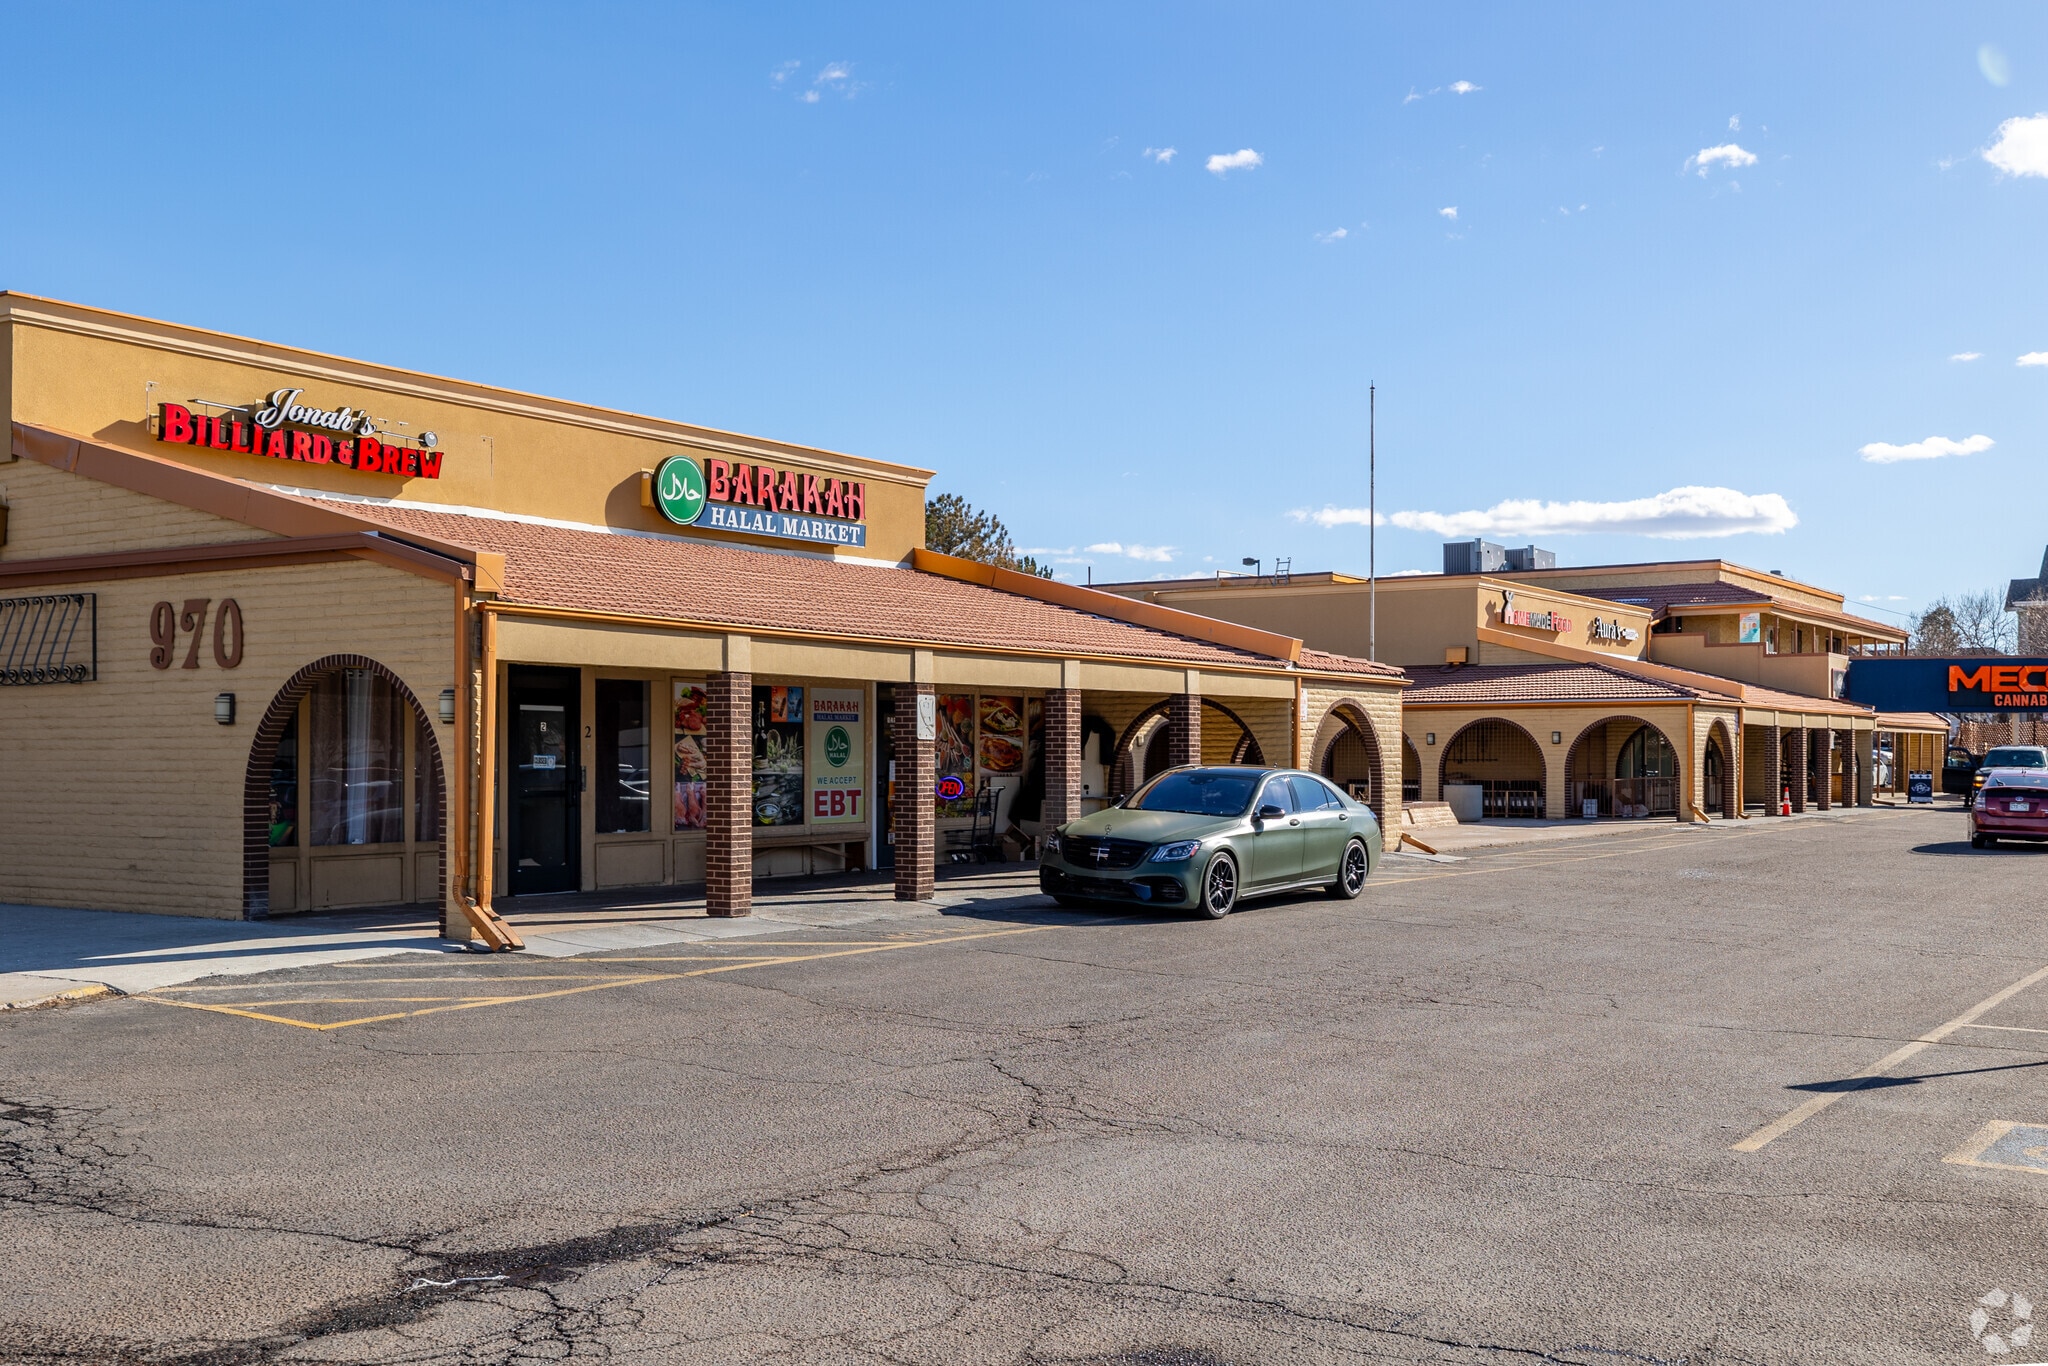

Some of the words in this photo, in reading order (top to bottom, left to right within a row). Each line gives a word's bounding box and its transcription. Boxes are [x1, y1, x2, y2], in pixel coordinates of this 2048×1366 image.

[255, 388, 376, 435] Jonah's
[160, 403, 333, 464] BILLIARD
[352, 435, 444, 479] BREW
[662, 472, 702, 501] حلال
[708, 458, 866, 520] BARAKAH
[710, 506, 777, 533] HALAL
[782, 516, 860, 544] MARKET
[150, 598, 244, 670] 970
[1948, 665, 2048, 692] MEC
[814, 700, 859, 712] BARAKAH
[585, 726, 591, 738] 2
[817, 777, 828, 785] WE
[829, 776, 857, 785] ACCEPT
[814, 789, 862, 817] EBT
